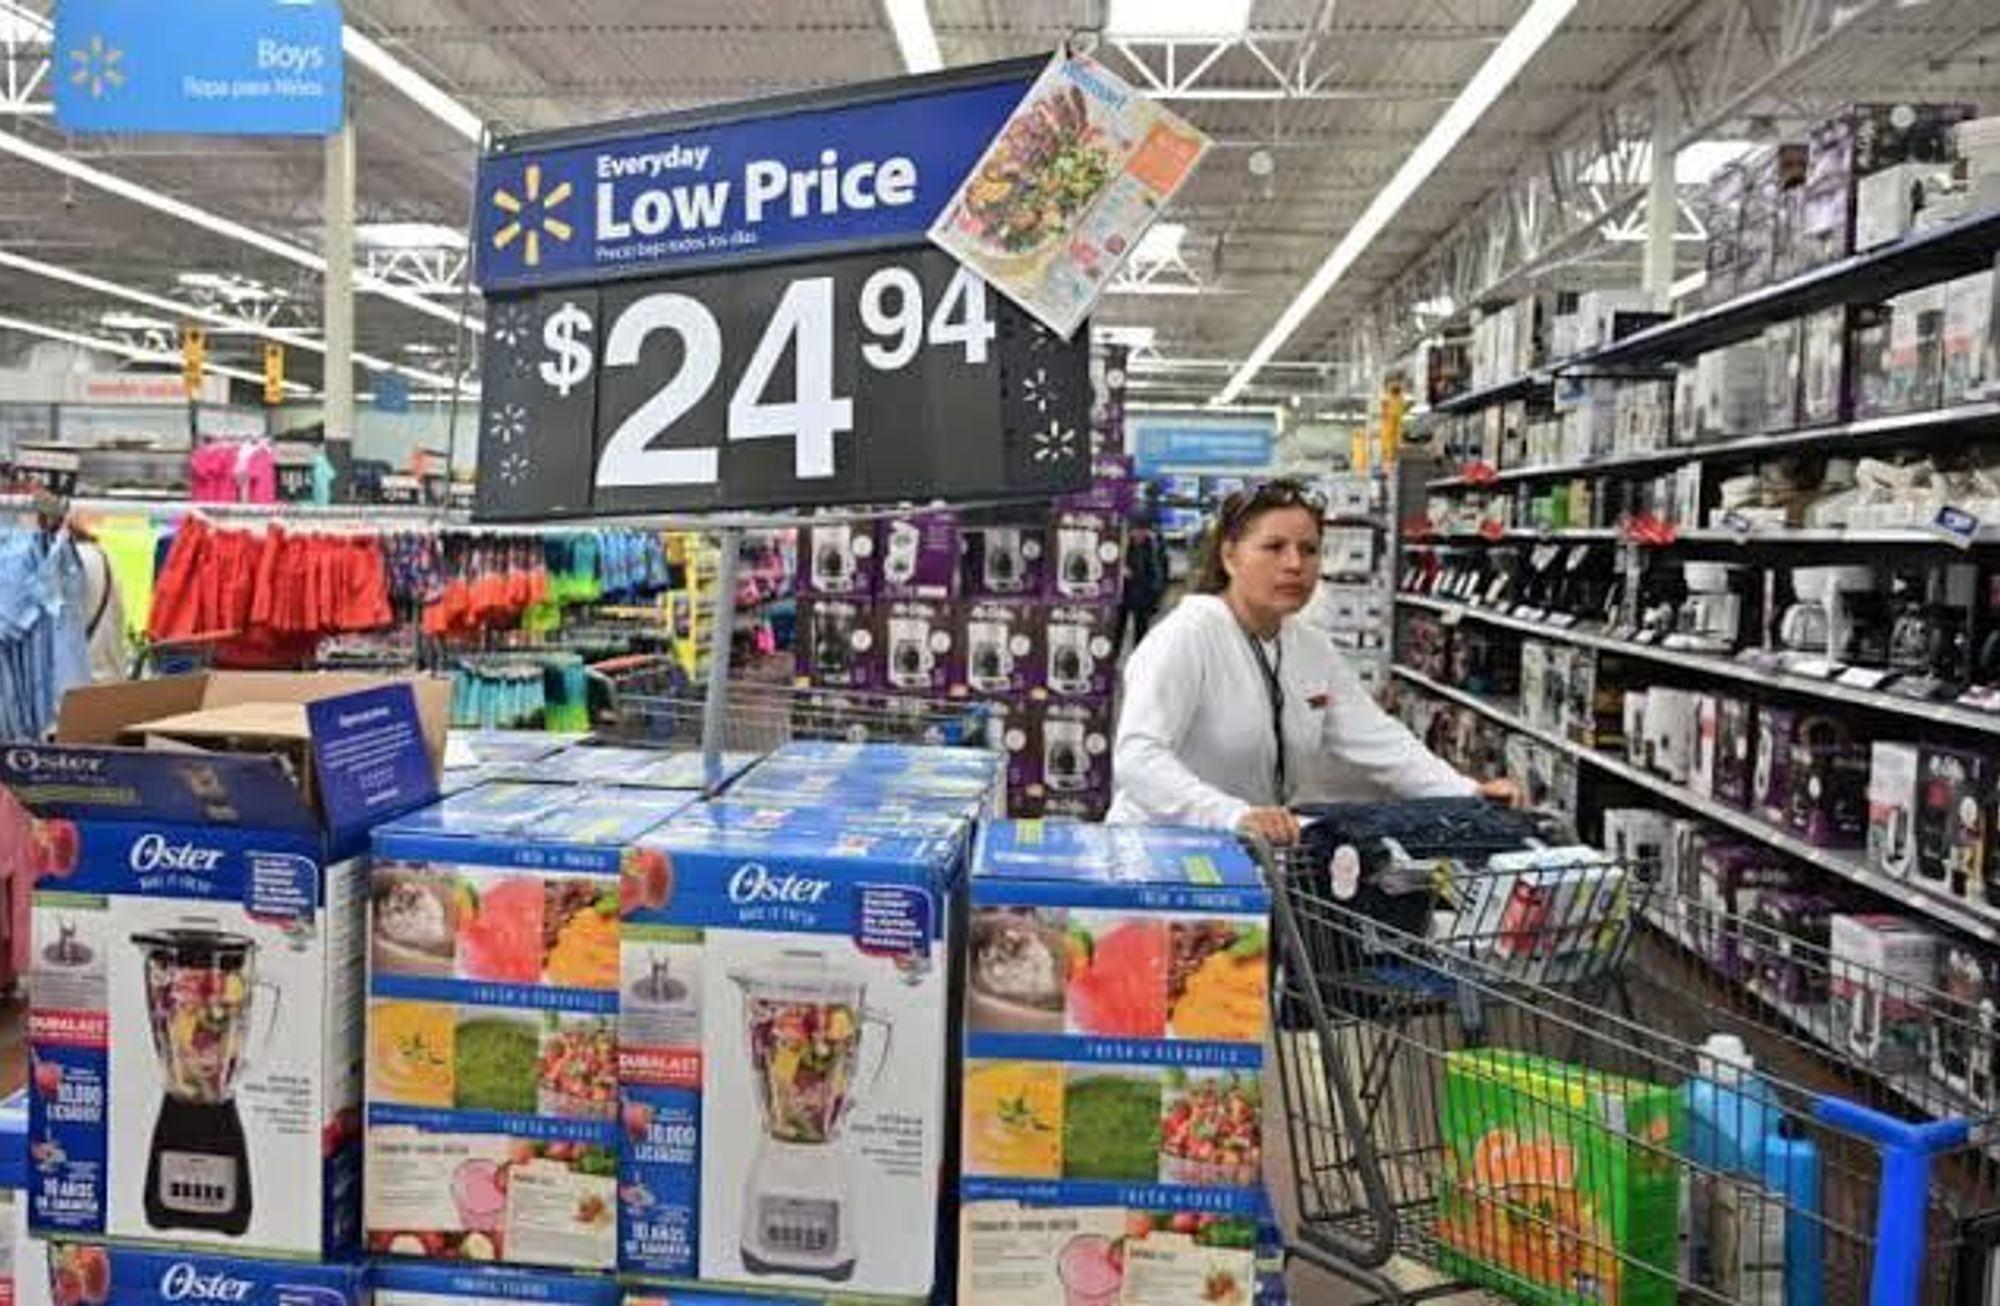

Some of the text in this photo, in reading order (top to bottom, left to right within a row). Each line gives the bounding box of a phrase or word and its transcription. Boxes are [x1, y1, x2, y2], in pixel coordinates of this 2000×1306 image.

[256, 38, 325, 72] Boys
[597, 145, 711, 178] Everyday
[597, 149, 917, 240] Low Price
[130, 833, 225, 873] Oster
[728, 861, 831, 904] Oster
[161, 1261, 254, 1300] Oster
